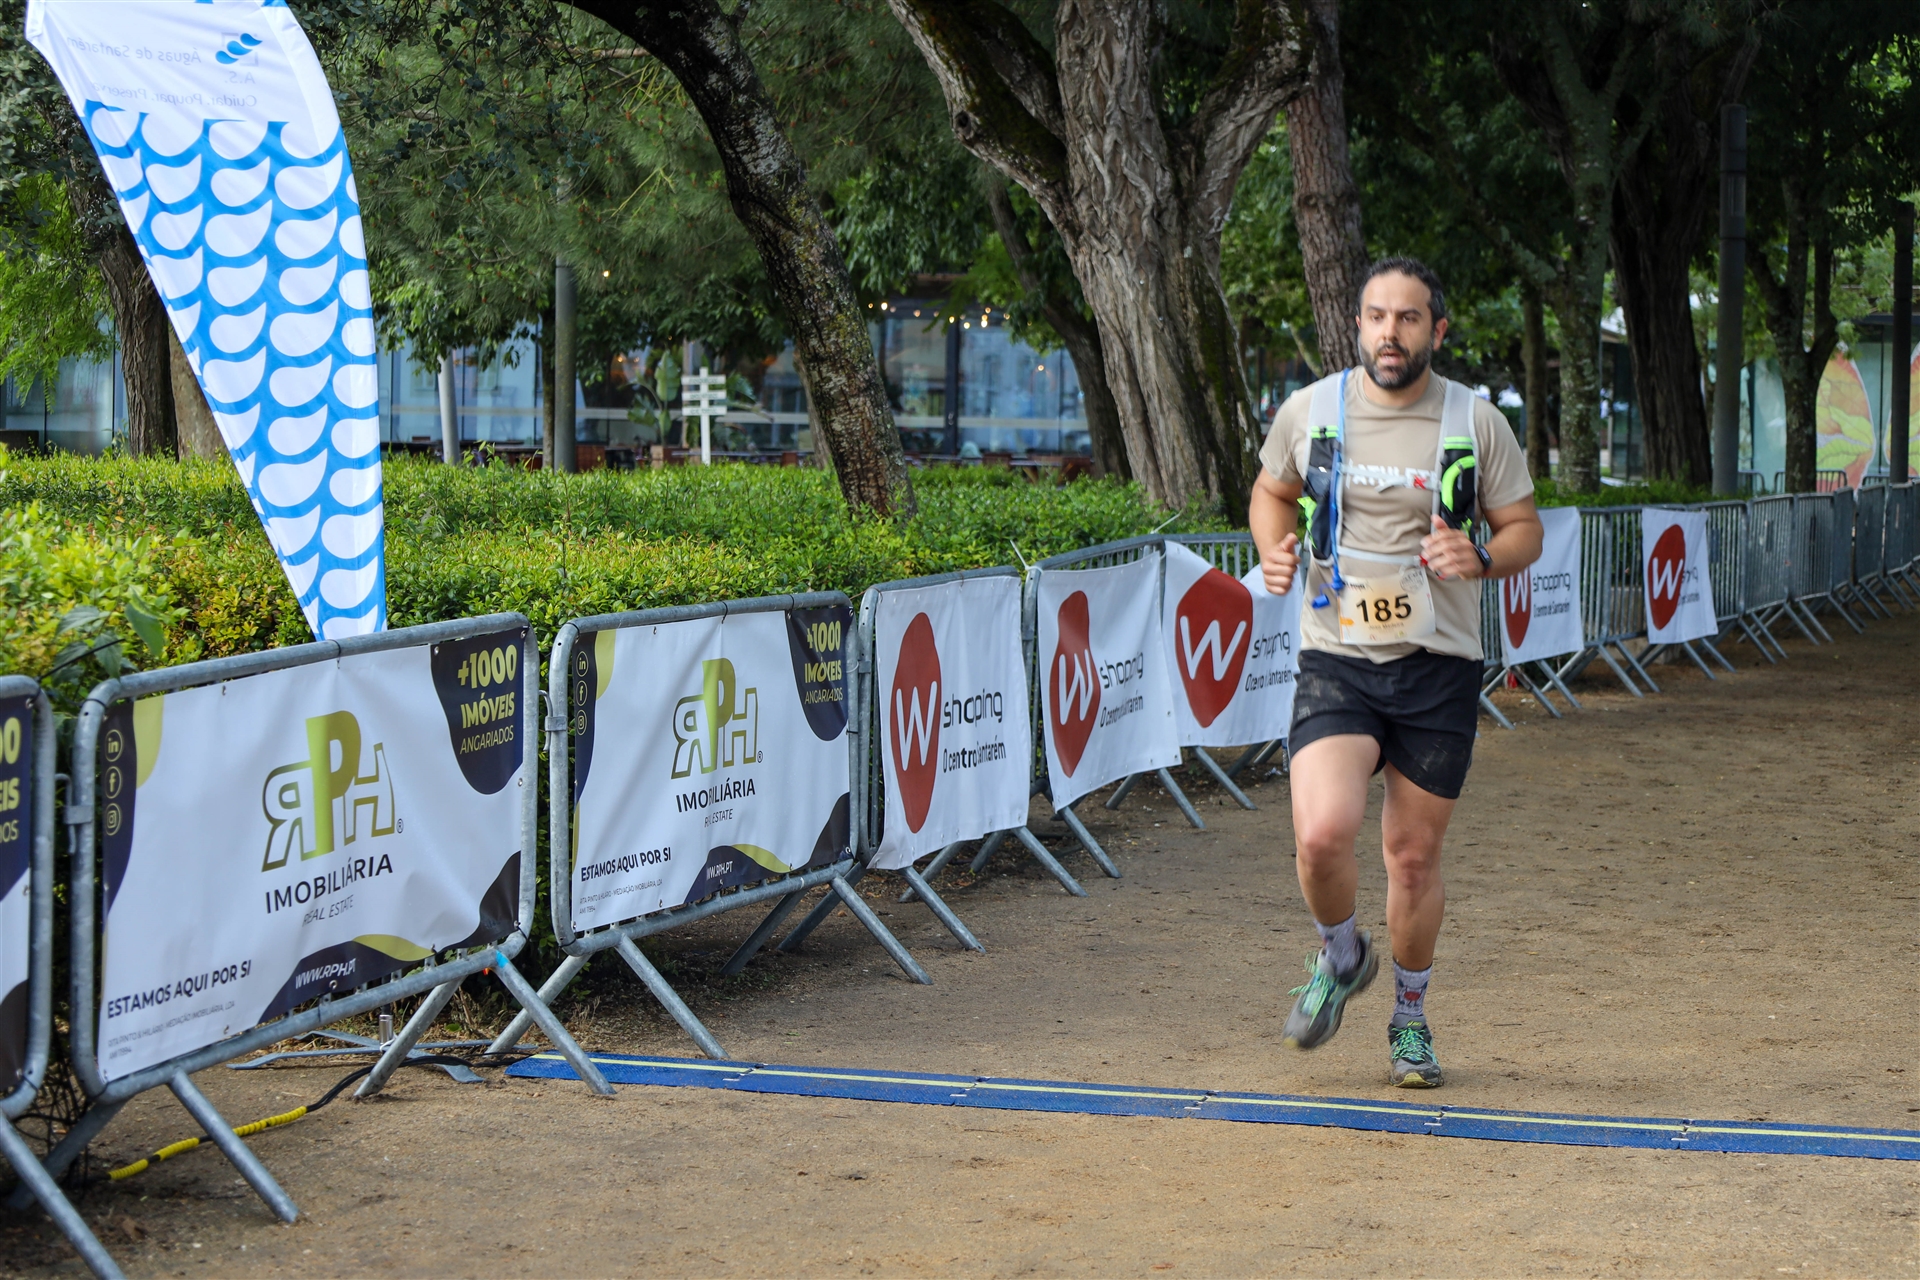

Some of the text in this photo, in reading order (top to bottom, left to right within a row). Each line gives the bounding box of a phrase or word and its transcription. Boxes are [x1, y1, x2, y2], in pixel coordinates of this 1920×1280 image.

[1652, 557, 1683, 600] W
[1356, 594, 1412, 622] 185
[807, 620, 841, 652] +1000
[1180, 615, 1248, 682] W
[458, 644, 517, 689] +1000
[804, 656, 842, 683] IMÓVEIS
[1268, 664, 1294, 686] antarém
[1058, 648, 1093, 726] W
[460, 692, 515, 728] IMÓVEIS
[896, 681, 936, 772] W
[460, 725, 514, 755] ANGARIADOS
[948, 748, 977, 772] centro
[978, 734, 1006, 764] antarém
[676, 777, 756, 813] IMOBILIÁRIA
[581, 847, 671, 882] ESTAMOS AQUI POR SI
[266, 854, 393, 914] IMOBILIÁRIA
[302, 894, 354, 927] REAL ESTATE
[107, 959, 252, 1019] ESTAMOS AQUI POR SI
[295, 958, 357, 989] WWW.RPH.PT
